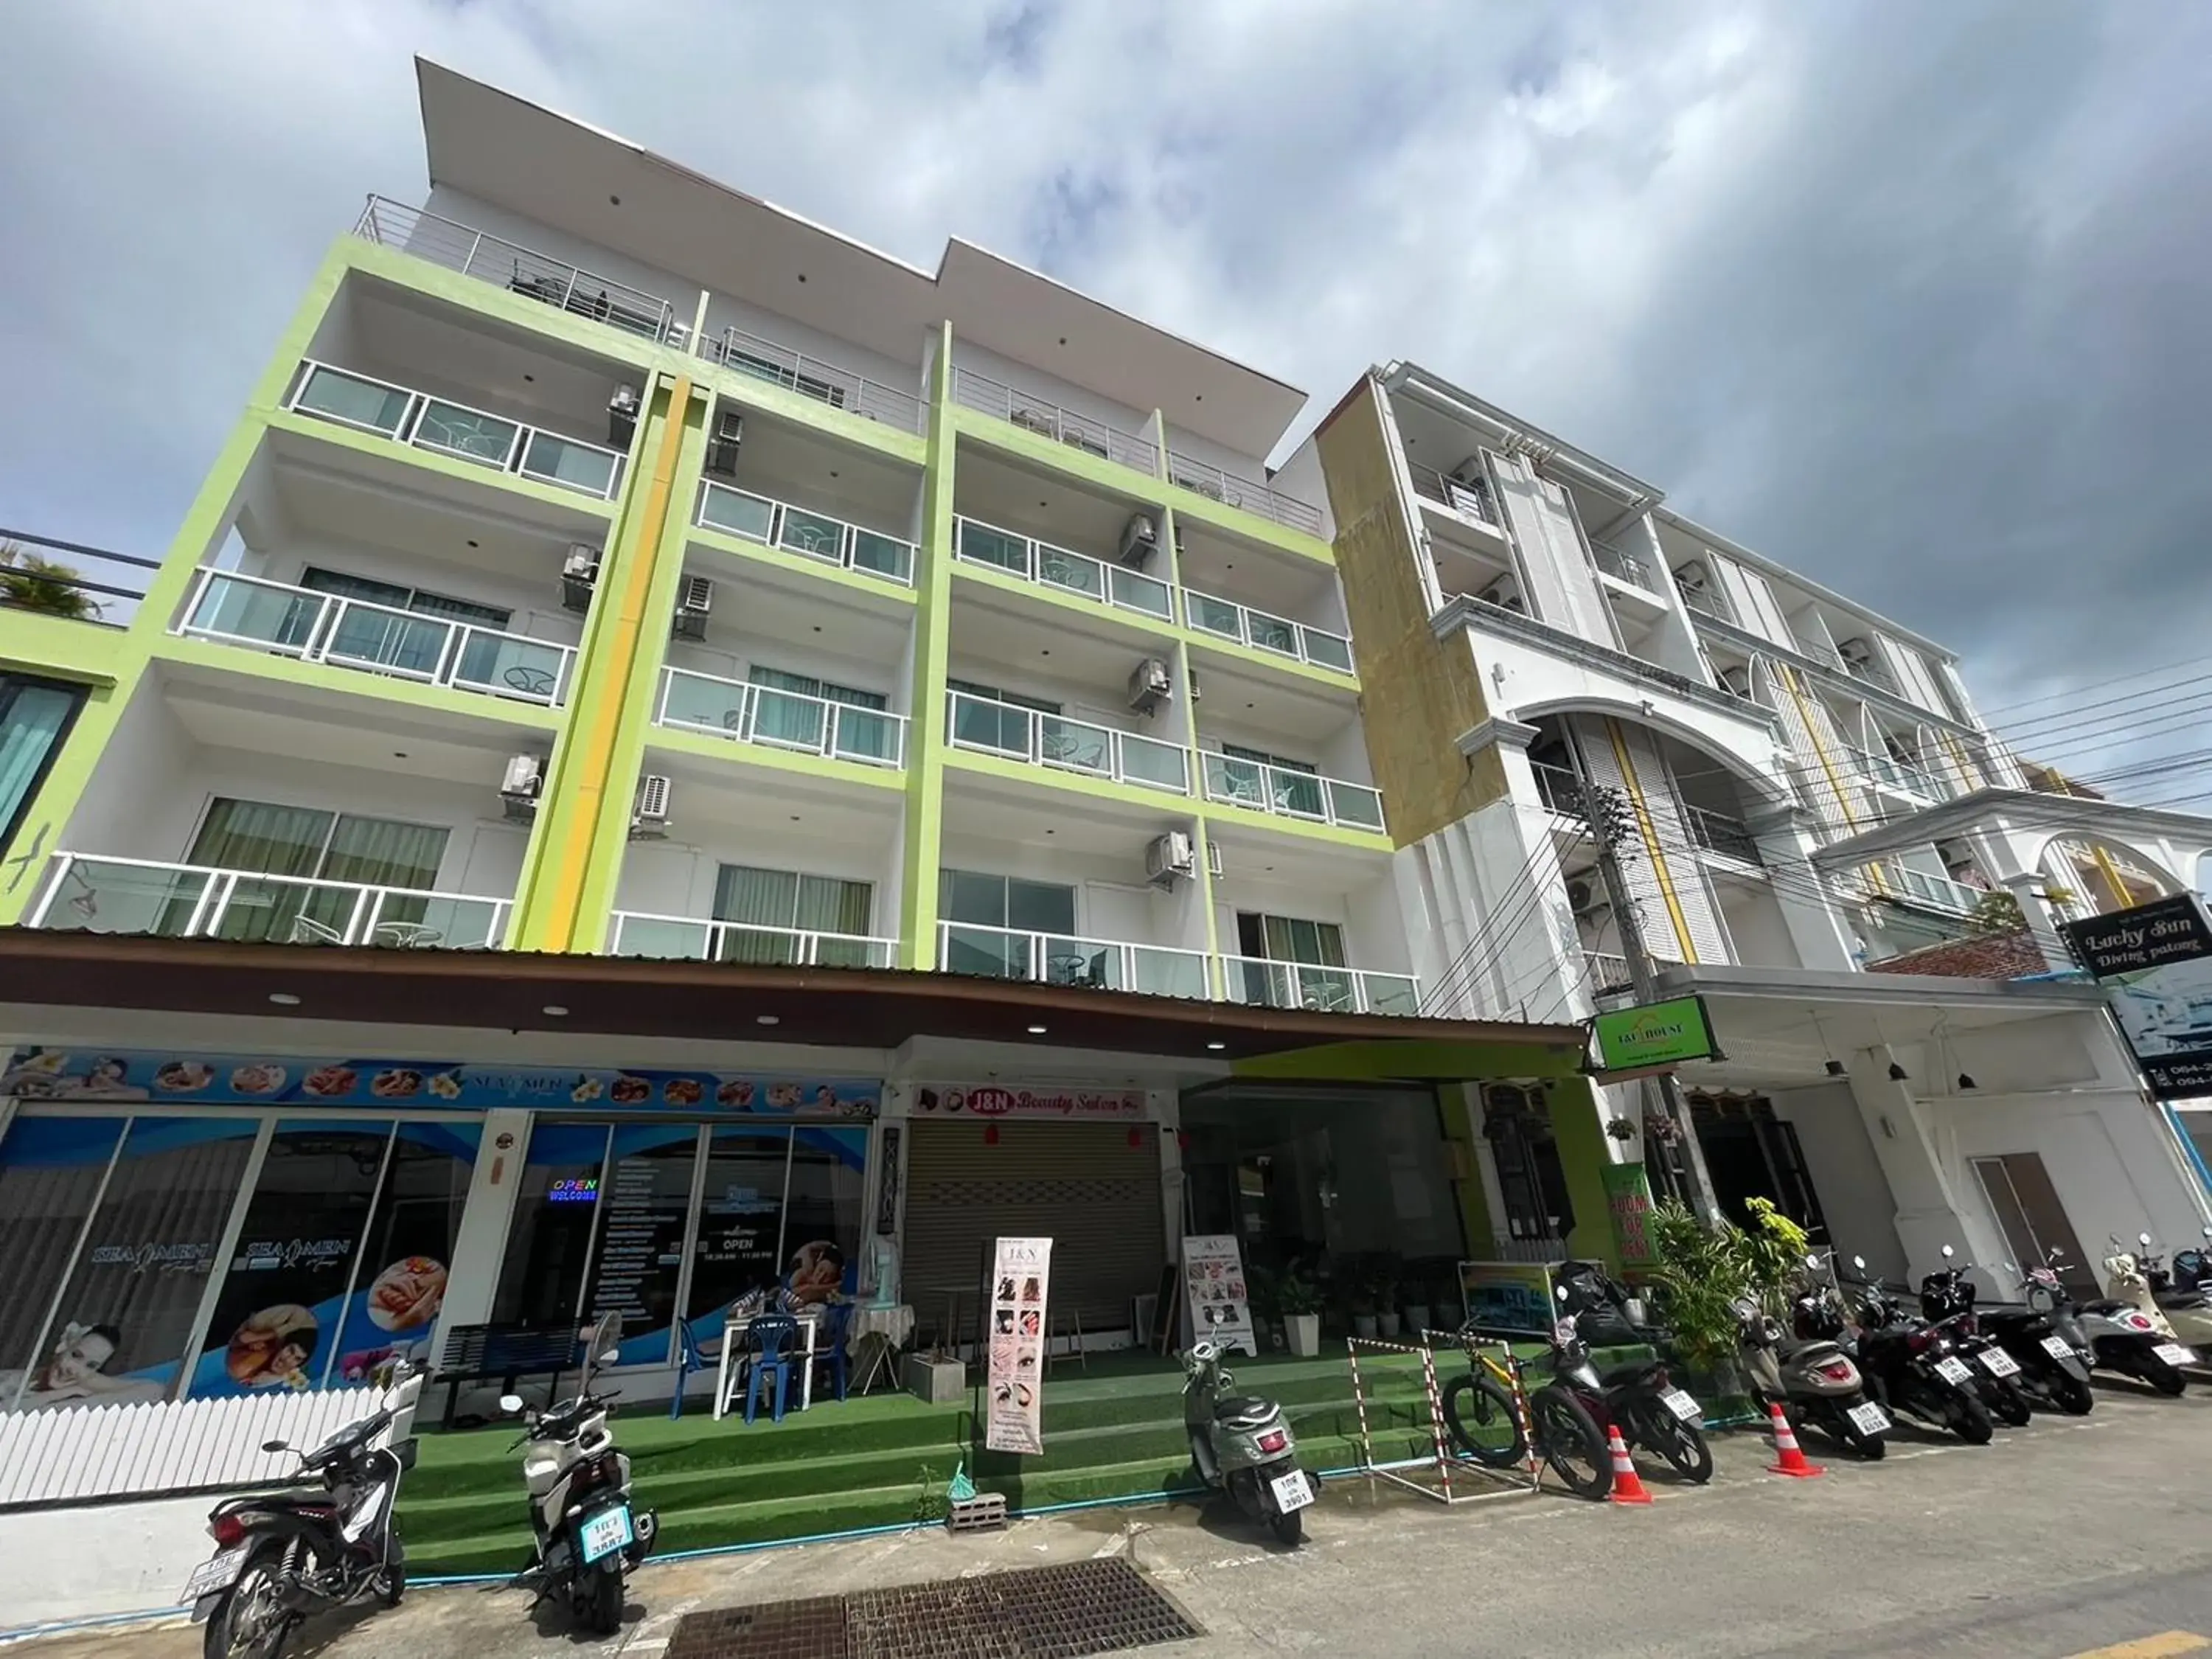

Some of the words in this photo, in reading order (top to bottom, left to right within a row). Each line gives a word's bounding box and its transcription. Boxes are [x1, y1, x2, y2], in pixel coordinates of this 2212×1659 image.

[2085, 928, 2145, 950] Lucky
[2150, 919, 2191, 937] Sun
[2098, 951, 2147, 967] Diving
[2149, 939, 2202, 959] patong
[973, 1091, 1008, 1110] J&N
[1015, 1091, 1072, 1114] Beauty
[1077, 1093, 1117, 1110] Salon
[554, 1180, 597, 1191] OPEN
[550, 1192, 597, 1201] WELCOME
[723, 1239, 753, 1250] OPEN
